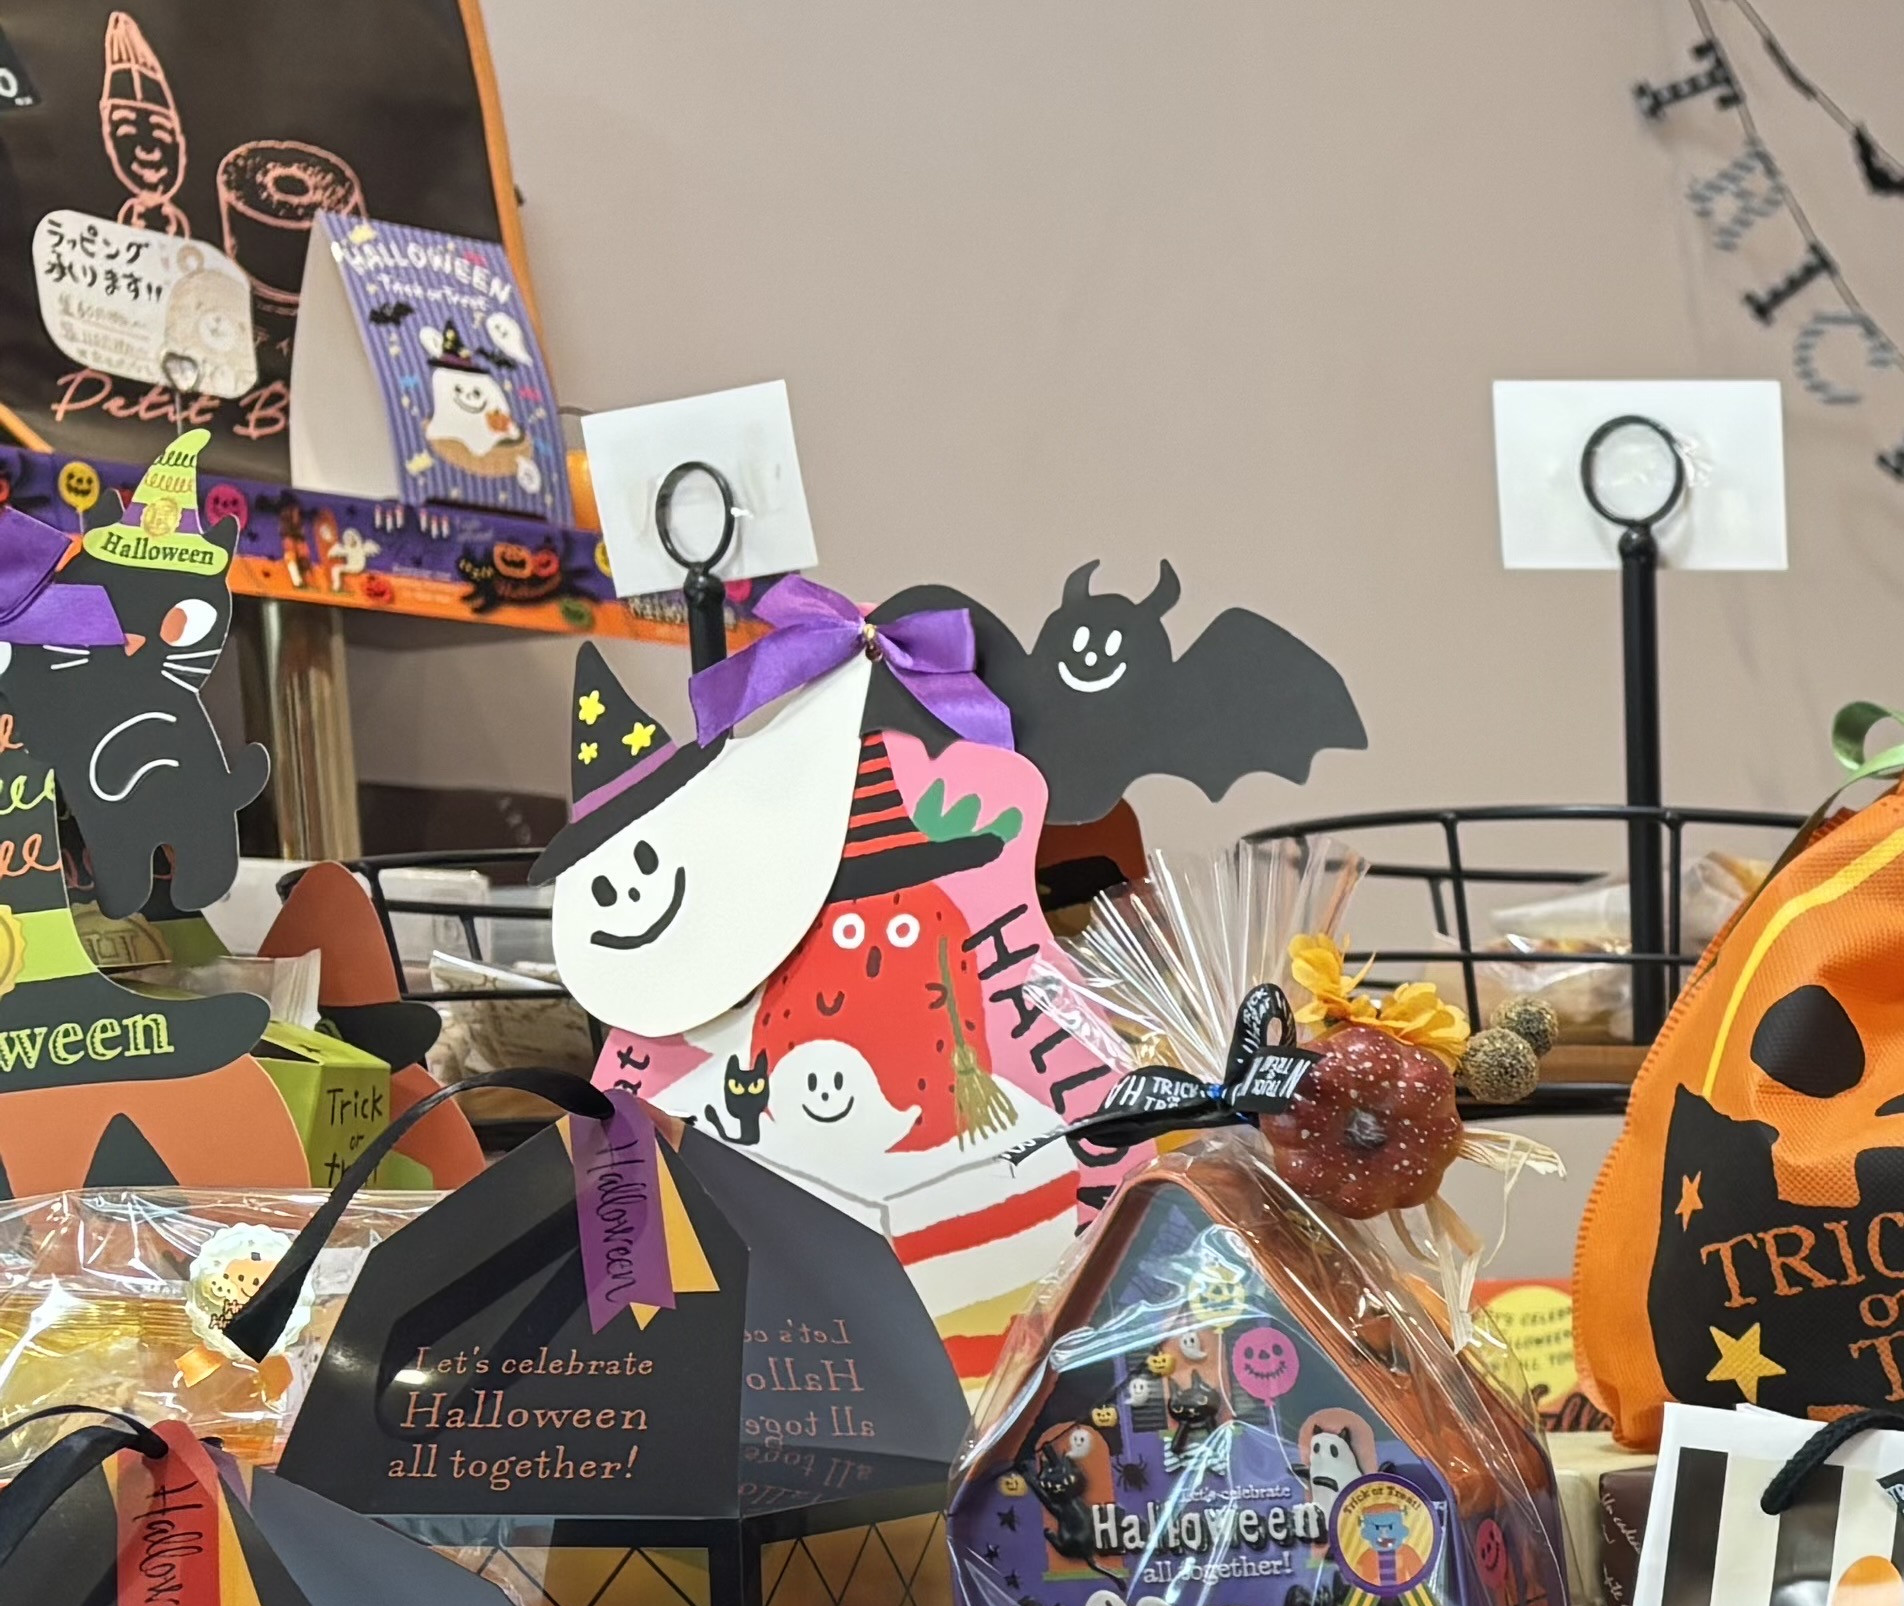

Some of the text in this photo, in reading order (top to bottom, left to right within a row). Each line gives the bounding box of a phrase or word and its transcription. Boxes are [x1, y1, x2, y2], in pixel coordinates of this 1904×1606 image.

[47, 218, 150, 264] ラッピング
[344, 242, 512, 303] HALLOWEEN
[101, 533, 214, 566] Halloween
[325, 1084, 384, 1128] Trick
[349, 1130, 365, 1152] or
[585, 1140, 648, 1303] Halloween
[415, 1345, 654, 1377] Let's celebrate
[400, 1390, 649, 1431] Halloween
[388, 1444, 640, 1492] all together!
[1092, 1503, 1328, 1556] Halloween
[1143, 1553, 1293, 1586] all together!
